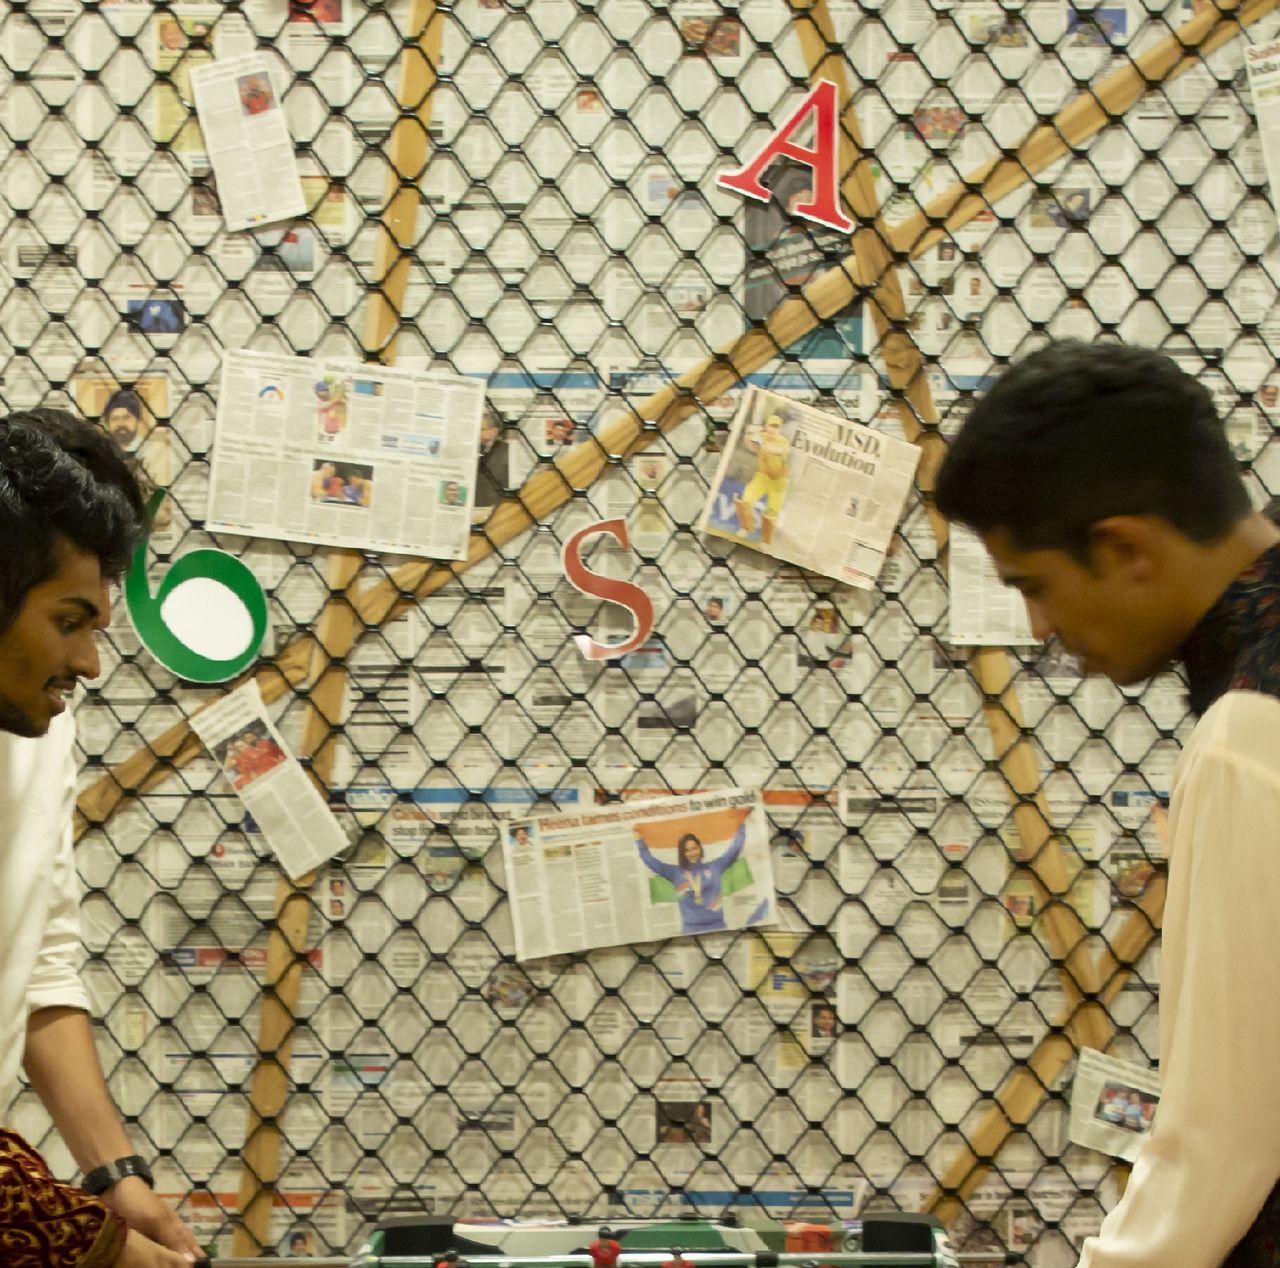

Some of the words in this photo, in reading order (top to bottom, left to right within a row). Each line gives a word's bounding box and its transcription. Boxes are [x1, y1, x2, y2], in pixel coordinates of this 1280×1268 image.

[717, 79, 856, 233] A
[791, 430, 877, 476] Evolution
[124, 487, 269, 683] 6
[561, 518, 656, 661] S
[623, 802, 687, 822] conditions
[689, 798, 701, 811] to
[703, 793, 726, 808] win
